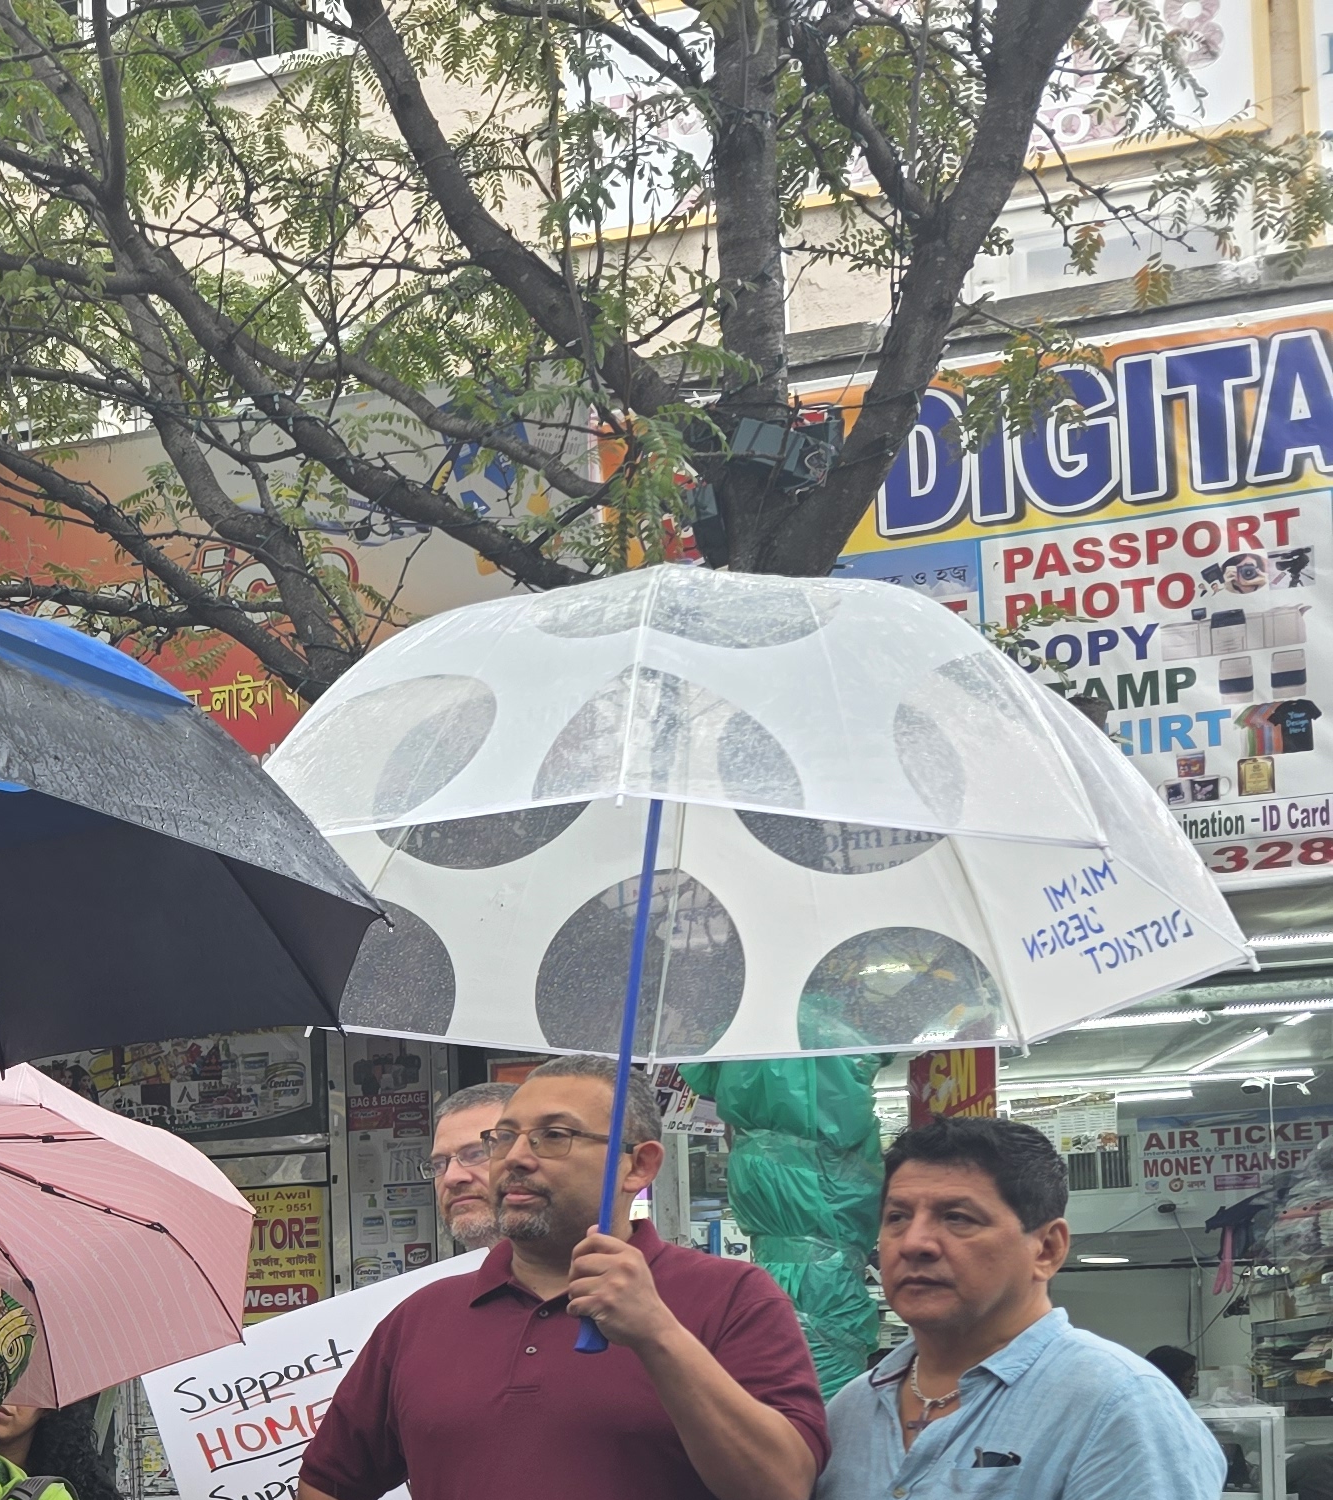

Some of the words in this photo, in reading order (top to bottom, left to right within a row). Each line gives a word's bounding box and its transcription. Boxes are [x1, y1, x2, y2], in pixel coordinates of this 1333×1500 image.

[1002, 508, 1301, 584] PASSPORT
[1004, 573, 1196, 631] PHOTO
[1286, 799, 1331, 830] Card
[268, 1079, 304, 1089] Centrum
[350, 1096, 370, 1108] BAG
[371, 1096, 379, 1107] &
[380, 1092, 427, 1106] BAGGAGE
[676, 1121, 694, 1131] Card
[1143, 1130, 1200, 1151] AIR
[1210, 1121, 1333, 1147] TICKET
[1143, 1154, 1215, 1178] MONEY
[273, 1189, 311, 1201] Awal
[286, 1203, 313, 1213] 9551
[250, 1216, 322, 1252] TORE
[173, 1338, 355, 1414] Support
